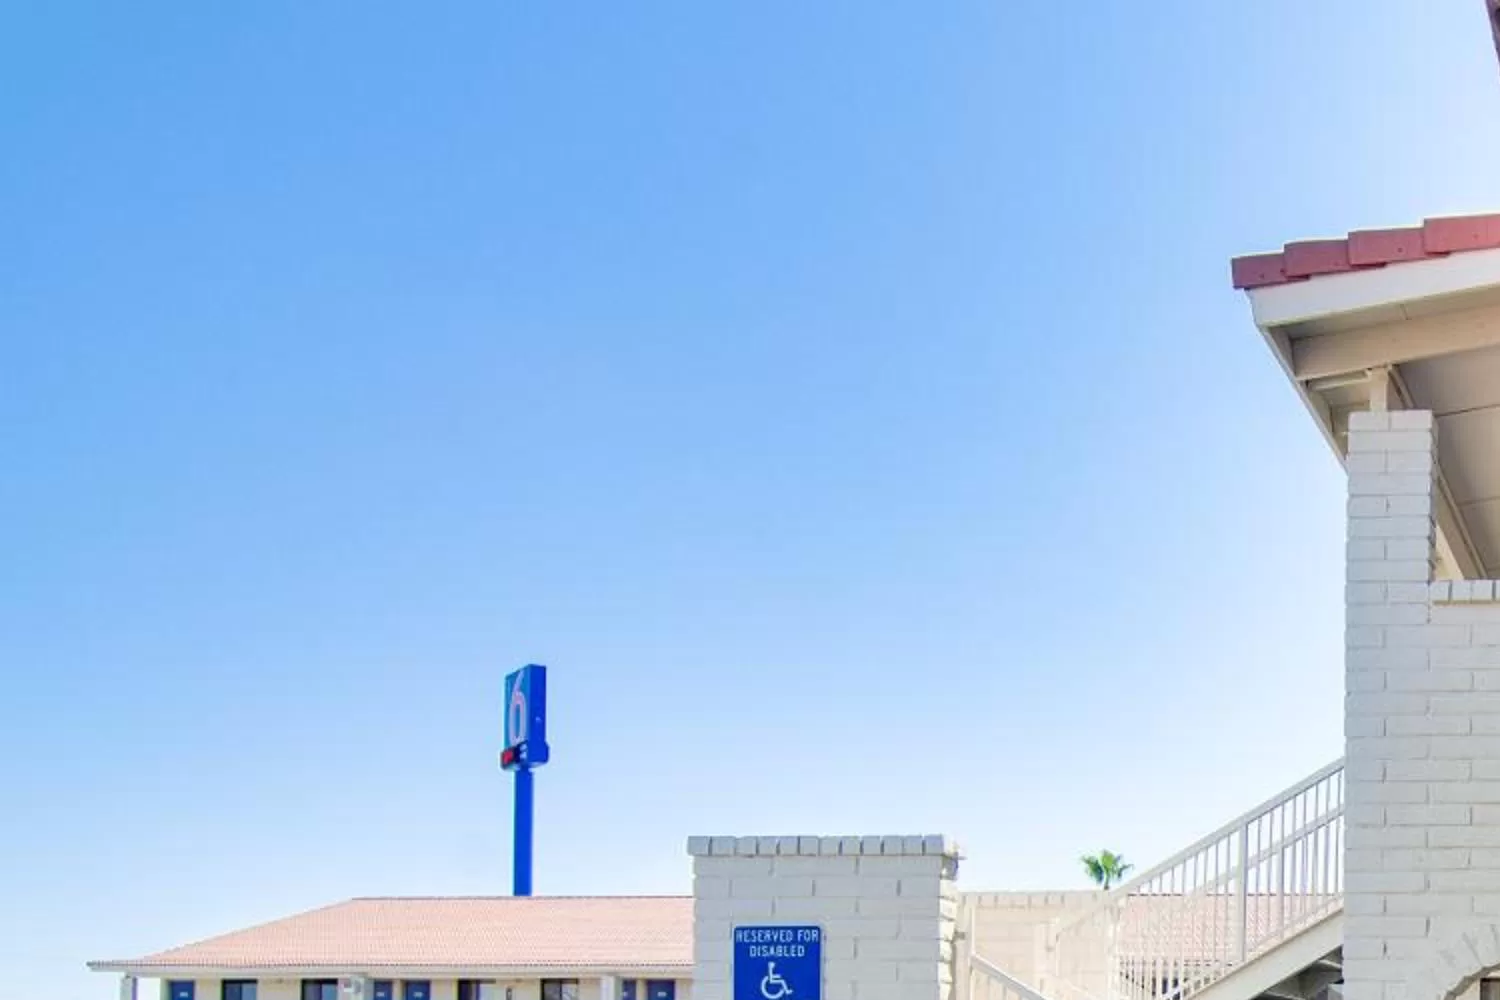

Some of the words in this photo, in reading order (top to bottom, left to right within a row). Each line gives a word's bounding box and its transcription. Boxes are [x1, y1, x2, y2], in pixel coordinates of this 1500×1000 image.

[508, 669, 527, 747] 6
[736, 929, 793, 943] RESERVED
[797, 929, 818, 943] FOR
[749, 945, 805, 957] DISABLED
